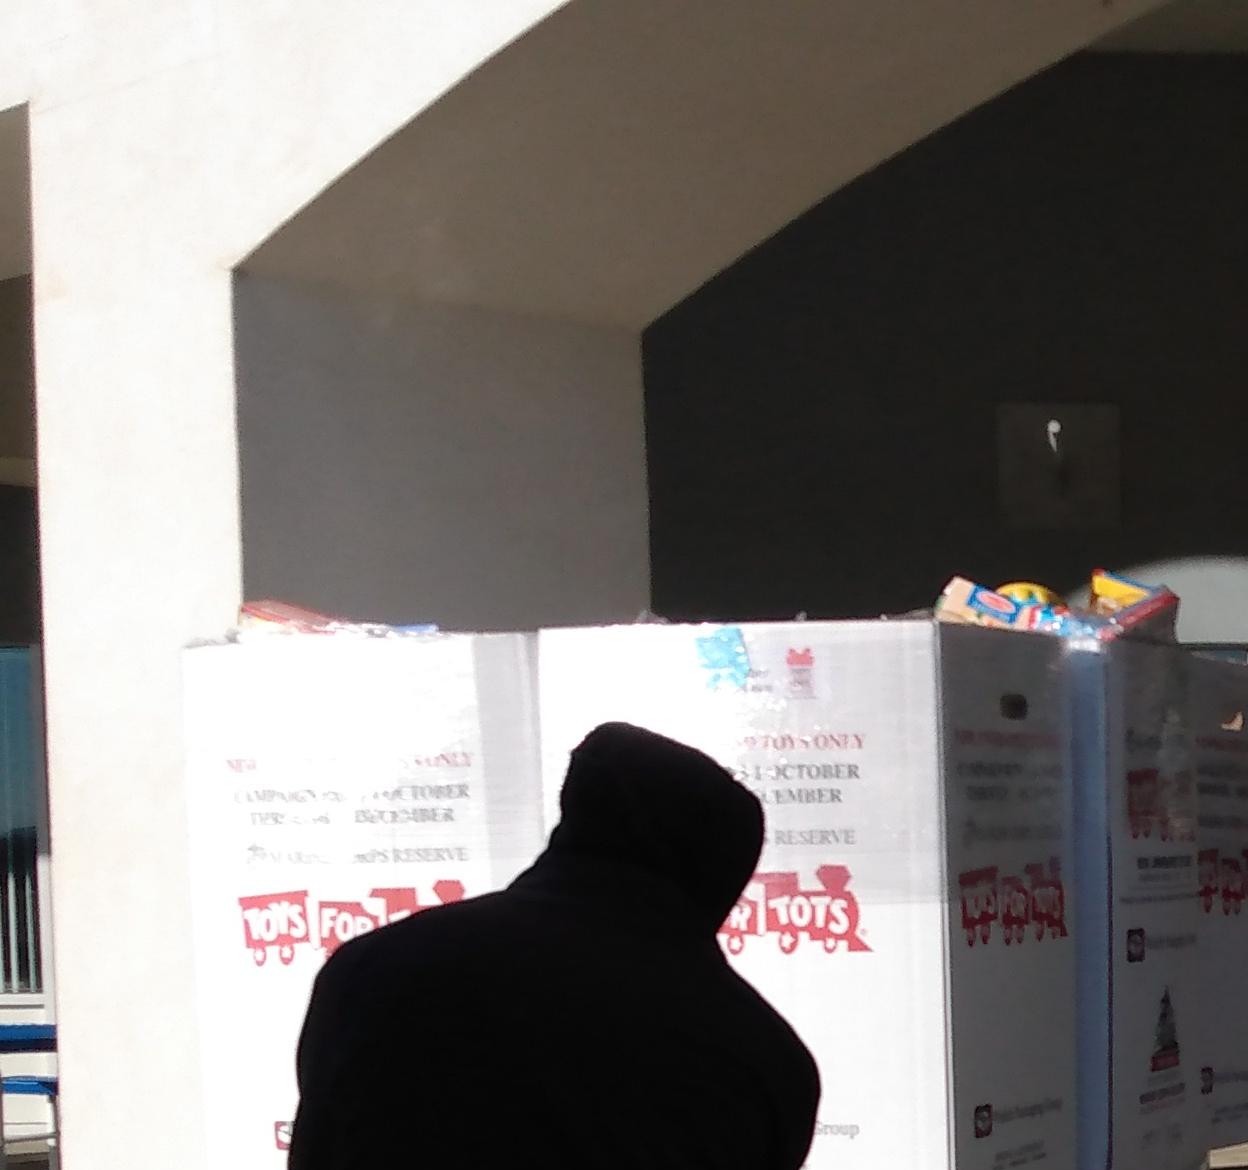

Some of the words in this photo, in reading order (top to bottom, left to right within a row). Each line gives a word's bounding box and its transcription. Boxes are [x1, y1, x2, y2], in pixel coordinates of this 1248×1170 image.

[762, 733, 810, 750] TOYS
[813, 732, 865, 750] ONLY
[773, 828, 858, 846] RESERVE
[244, 903, 308, 942] TOYS
[768, 895, 851, 935] TOTS
